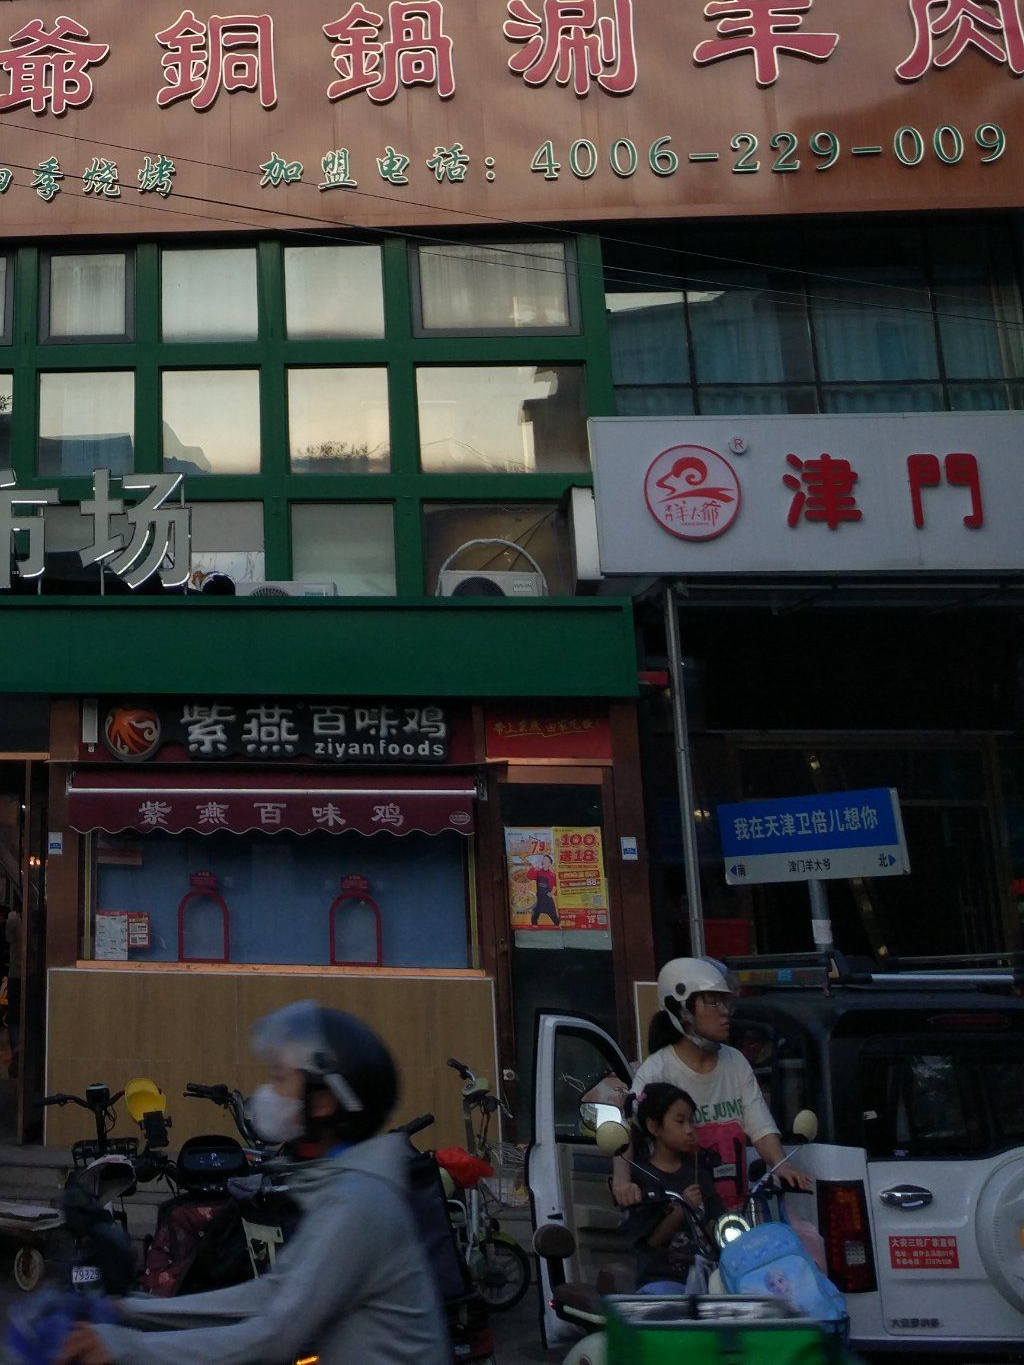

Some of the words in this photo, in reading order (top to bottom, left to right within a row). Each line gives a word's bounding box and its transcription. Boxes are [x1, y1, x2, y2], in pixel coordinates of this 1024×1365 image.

[314, 739, 445, 758] ziyanfoods
[137, 801, 404, 827] 紫燕百味鸡
[733, 805, 879, 841] 我在天津卫倍儿想你
